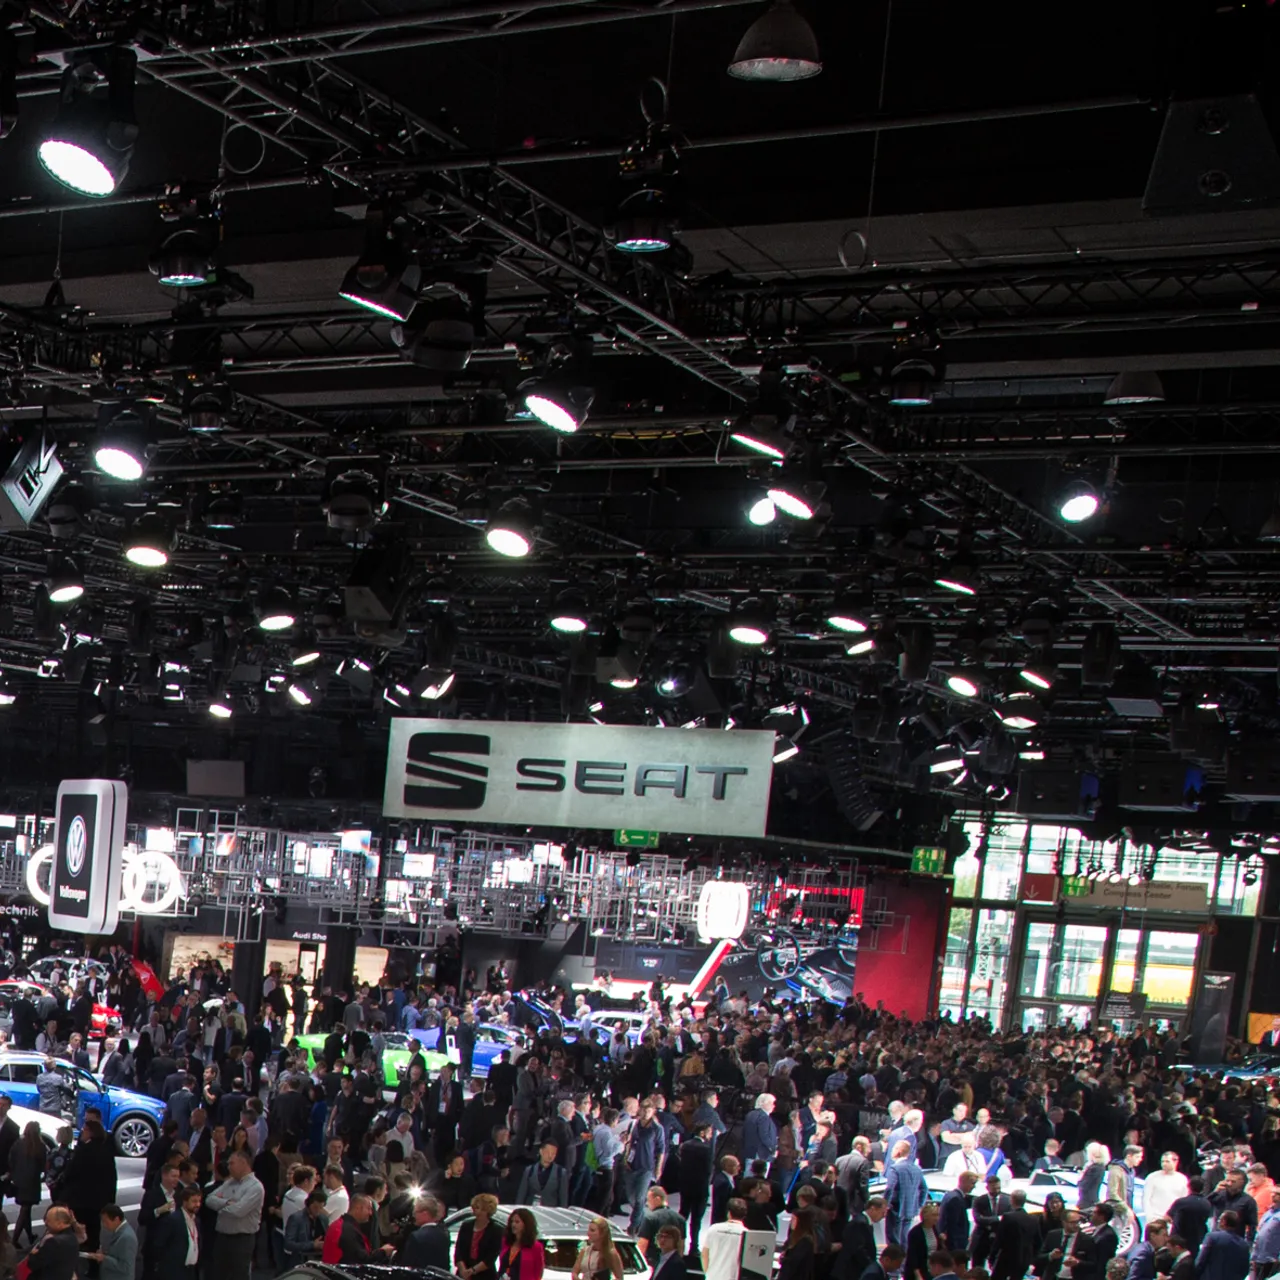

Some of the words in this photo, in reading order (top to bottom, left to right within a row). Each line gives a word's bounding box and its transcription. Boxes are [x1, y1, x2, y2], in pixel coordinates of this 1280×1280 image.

[515, 757, 748, 800] SEAT
[292, 931, 311, 940] Audi
[312, 933, 328, 941] Sho
